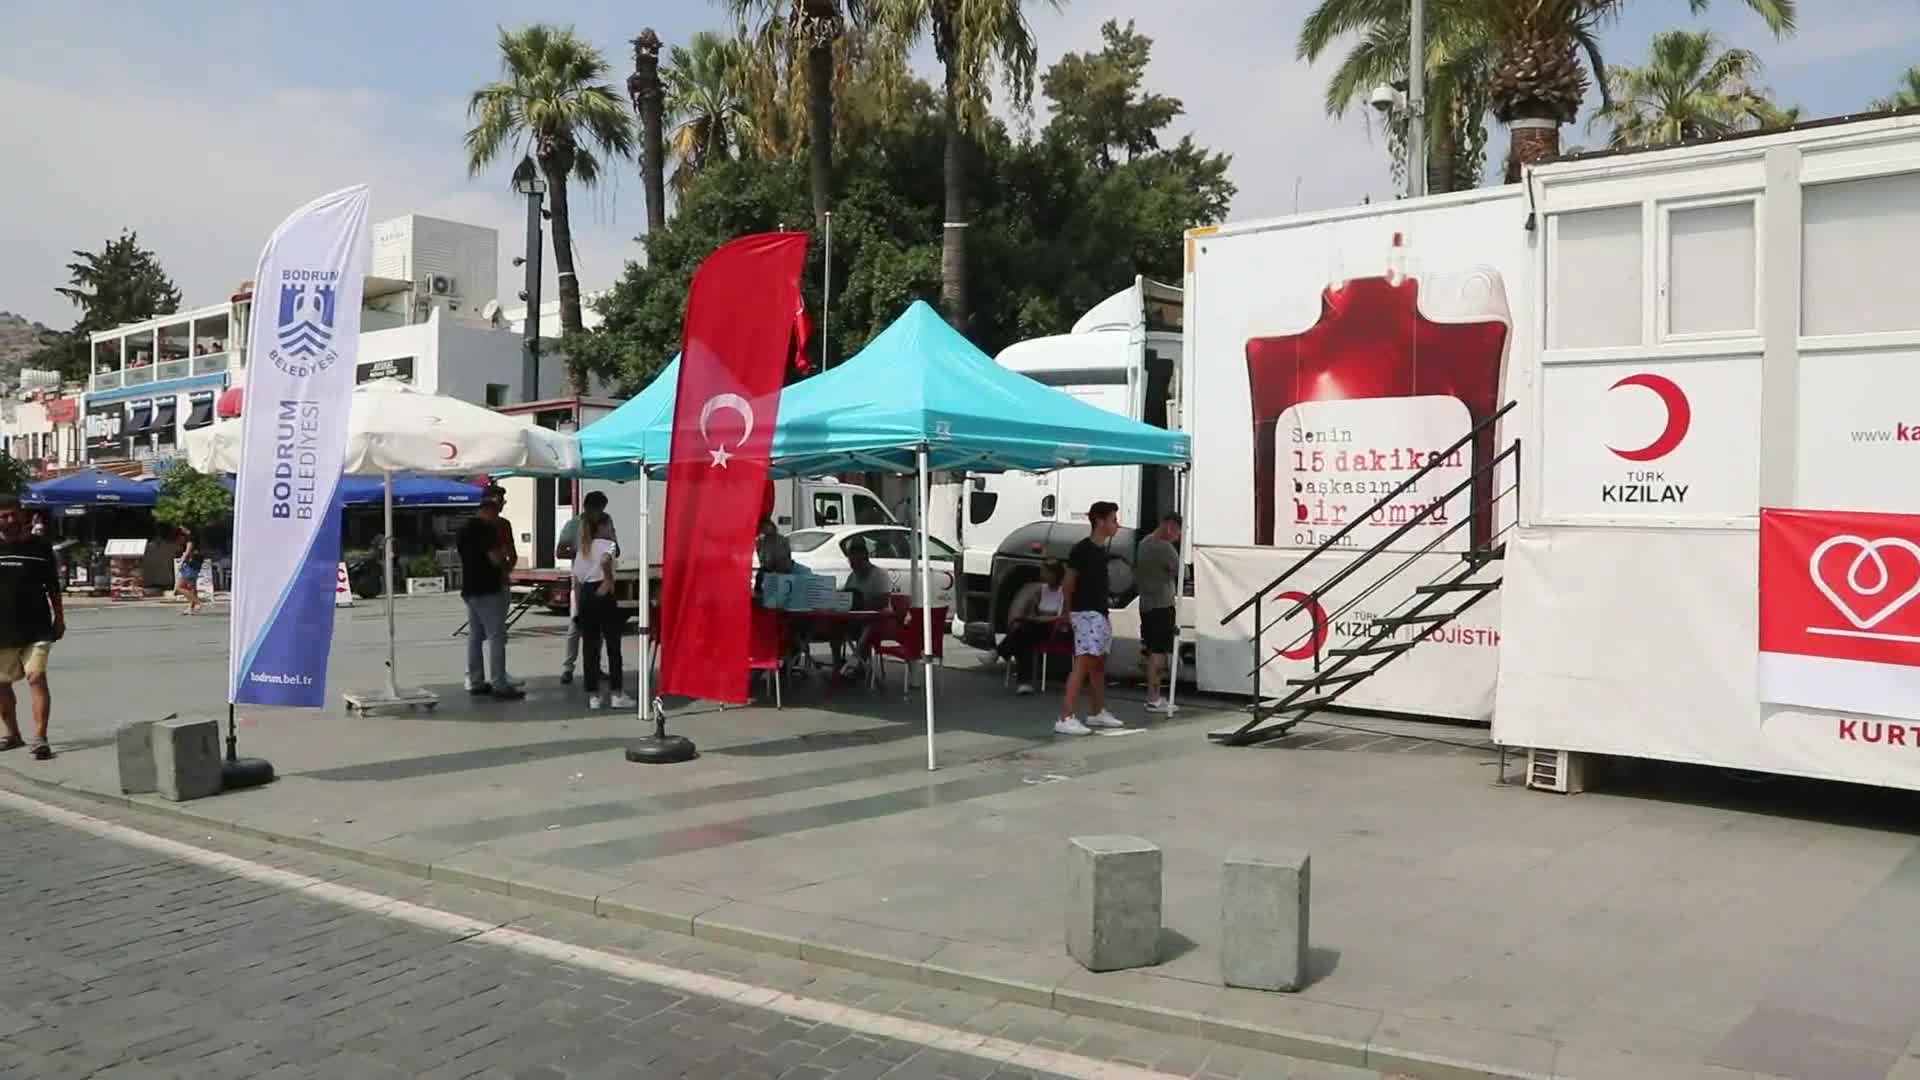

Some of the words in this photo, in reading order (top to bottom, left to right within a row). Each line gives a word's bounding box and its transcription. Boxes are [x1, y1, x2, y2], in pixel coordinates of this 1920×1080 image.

[1292, 428, 1352, 443] Senin
[272, 400, 298, 519] BODRUM
[1293, 451, 1323, 472] 15
[1335, 448, 1463, 471] dakikan
[1626, 469, 1665, 482] TÜRK
[1602, 484, 1689, 503] KIZILAY
[1293, 498, 1347, 522] bir
[1839, 719, 1920, 748] KURT
